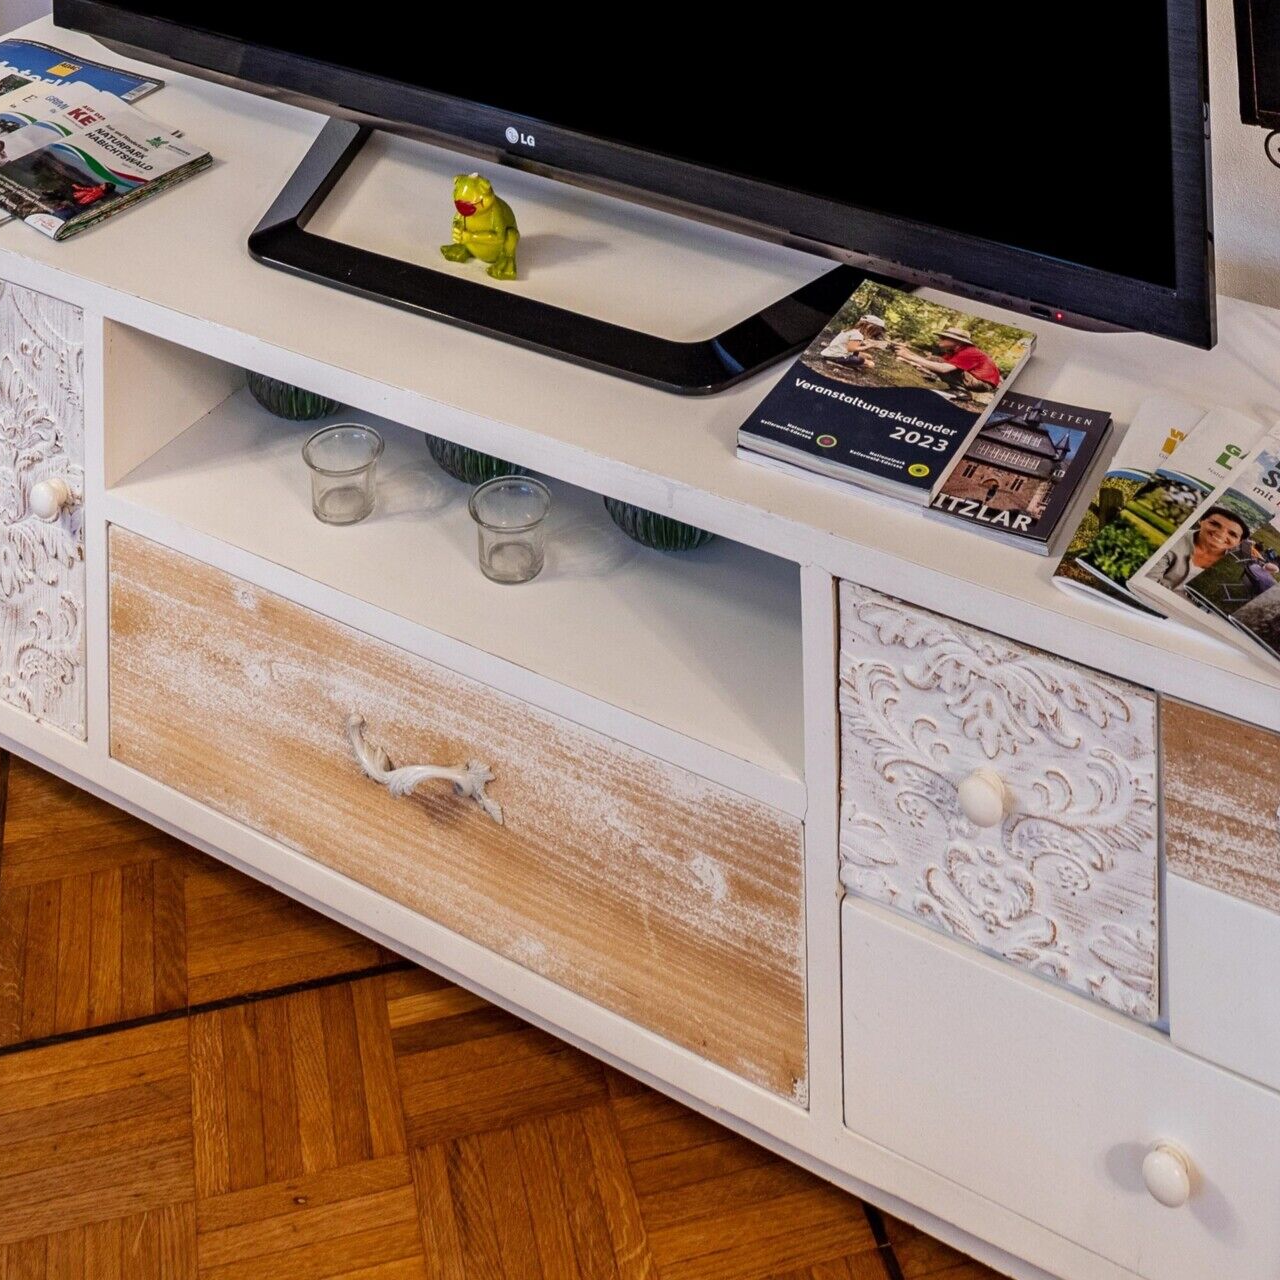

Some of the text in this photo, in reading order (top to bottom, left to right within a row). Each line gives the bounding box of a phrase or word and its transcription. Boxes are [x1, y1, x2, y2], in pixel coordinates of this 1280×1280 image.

[85, 132, 154, 171] HABICHTSWALD
[94, 128, 148, 160] NATURPARK
[521, 133, 536, 147] LG
[794, 378, 958, 437] Veranstaltungskalender
[1041, 409, 1094, 427] SEITEN
[889, 426, 949, 453] 2023
[1253, 486, 1274, 502] mit
[932, 493, 1033, 533] ITZLAR
